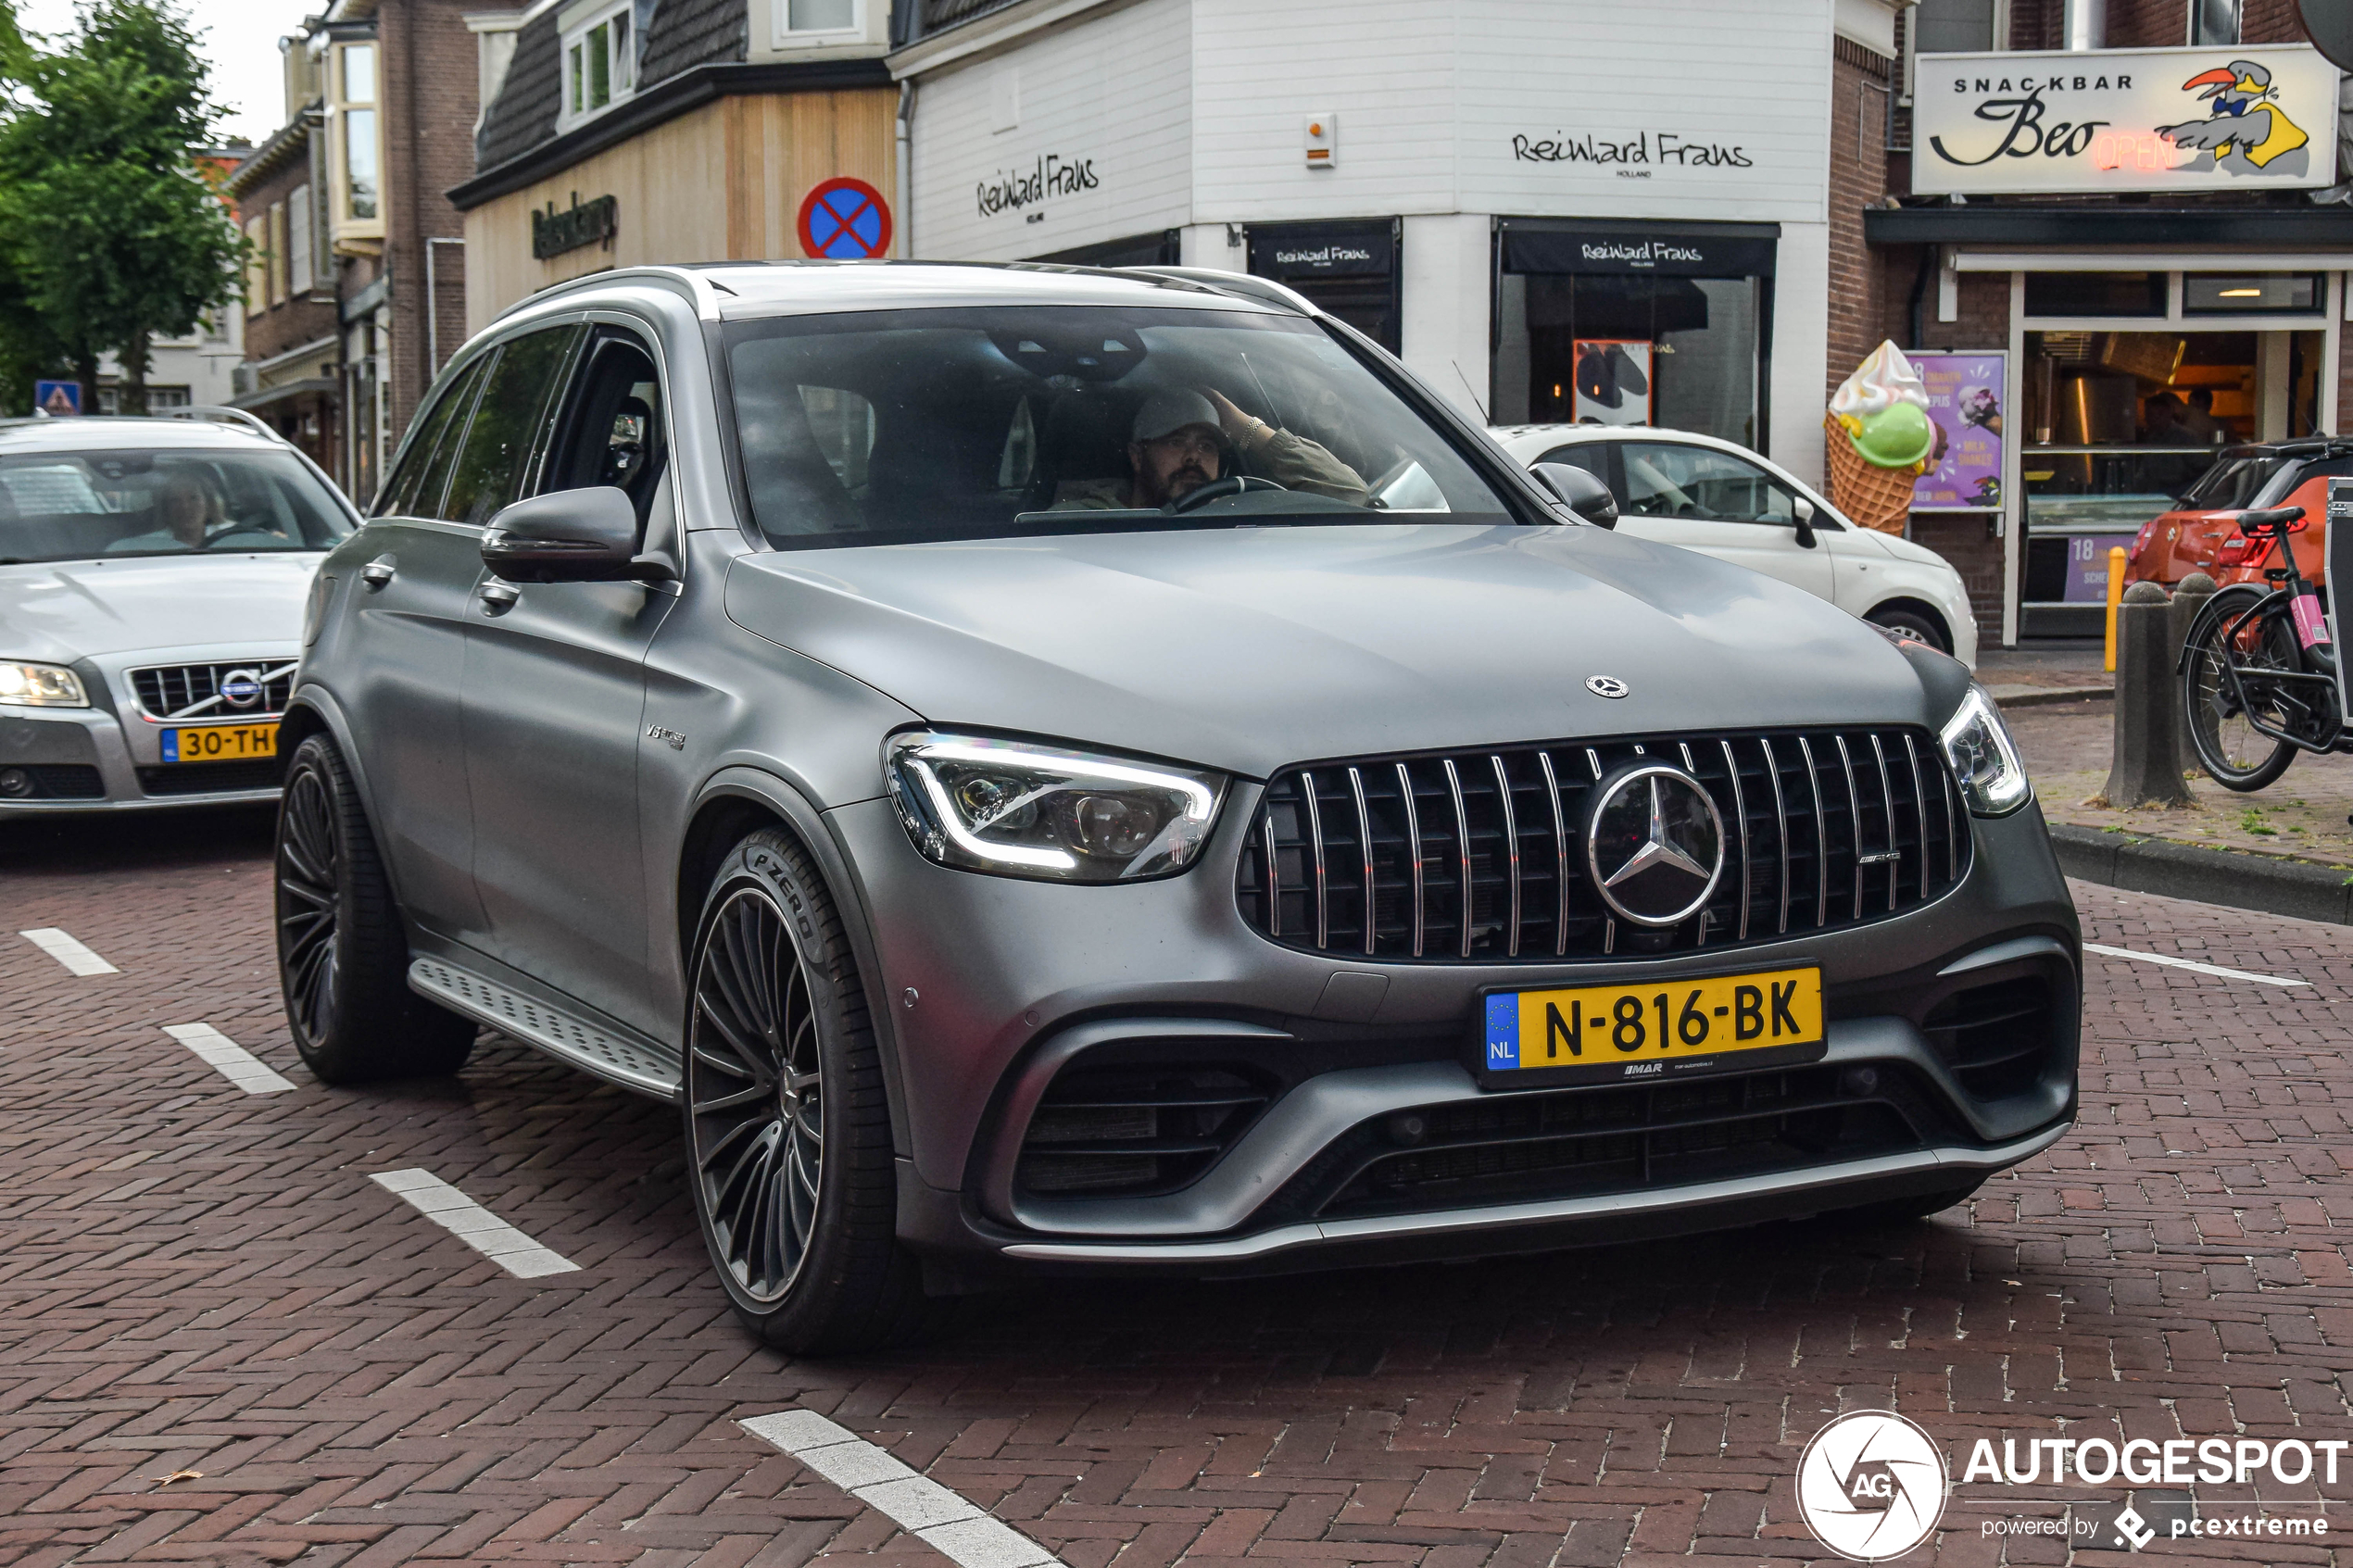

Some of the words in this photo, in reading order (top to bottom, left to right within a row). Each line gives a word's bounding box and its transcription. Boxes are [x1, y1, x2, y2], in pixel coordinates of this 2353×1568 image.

[1953, 75, 2133, 93] SNACKBAR
[1929, 84, 2111, 167] Beo
[1512, 130, 1650, 164] Reinhard
[1658, 133, 1754, 168] Frans
[2095, 134, 2175, 170] OPEN
[977, 154, 1044, 218] Reinhard
[1046, 154, 1099, 198] Frans
[1616, 169, 1652, 179] HOLLAND
[1331, 245, 1370, 259] Frans
[1581, 241, 1651, 260] Reinhard
[1653, 242, 1704, 261] Frans
[2073, 538, 2095, 561] 18
[185, 728, 278, 757] 30-TH
[753, 853, 769, 868] P
[767, 862, 814, 940] ZERO
[1545, 979, 1802, 1059] N-816-BK
[1491, 1041, 1515, 1060] NL
